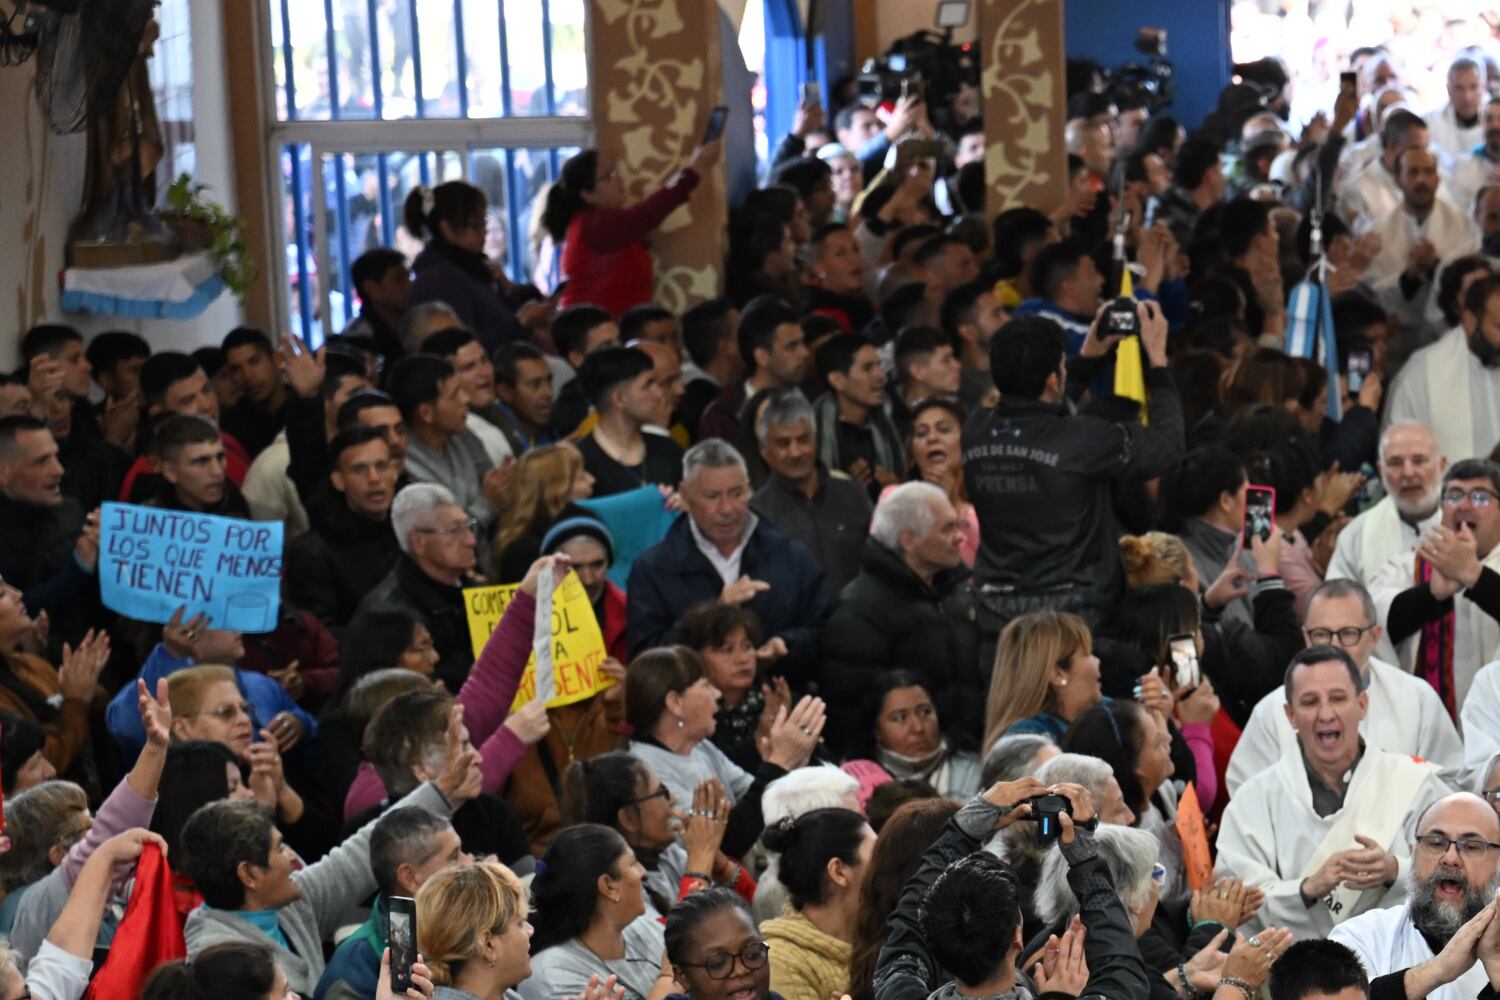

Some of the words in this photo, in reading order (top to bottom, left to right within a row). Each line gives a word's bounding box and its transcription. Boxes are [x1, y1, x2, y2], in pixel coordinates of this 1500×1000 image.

[110, 508, 212, 544] JUNTOS
[224, 524, 271, 552] POR
[108, 534, 150, 561] LOS
[164, 543, 206, 569] QUE
[216, 552, 282, 578] MENOS
[111, 559, 214, 603] TIENEN
